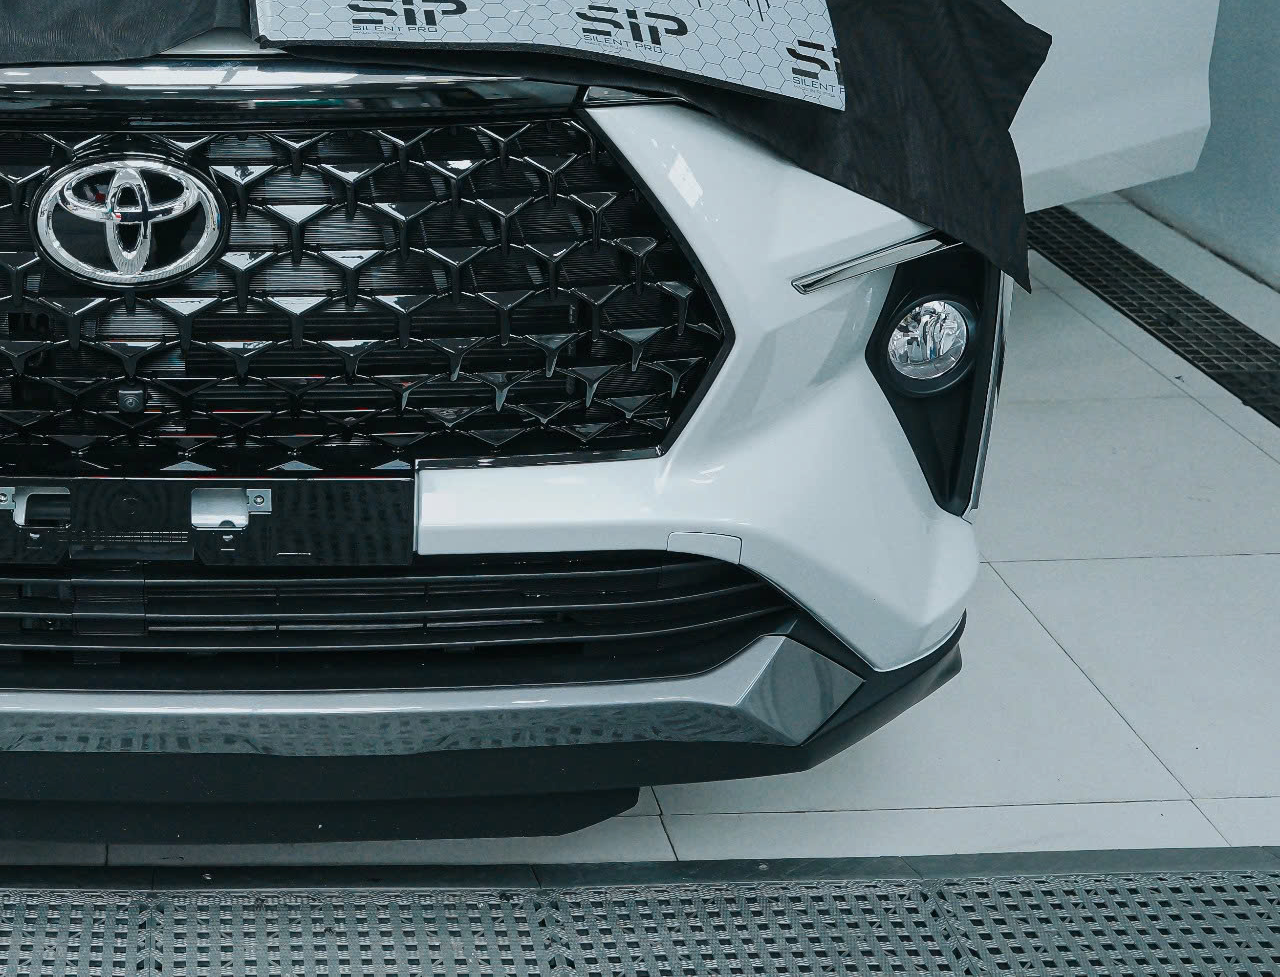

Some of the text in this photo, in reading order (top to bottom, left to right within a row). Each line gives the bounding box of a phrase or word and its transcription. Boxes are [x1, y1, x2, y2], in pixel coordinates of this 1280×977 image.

[583, 34, 631, 48] SILENT
[636, 42, 662, 54] PRO
[792, 76, 835, 93] SILENT
